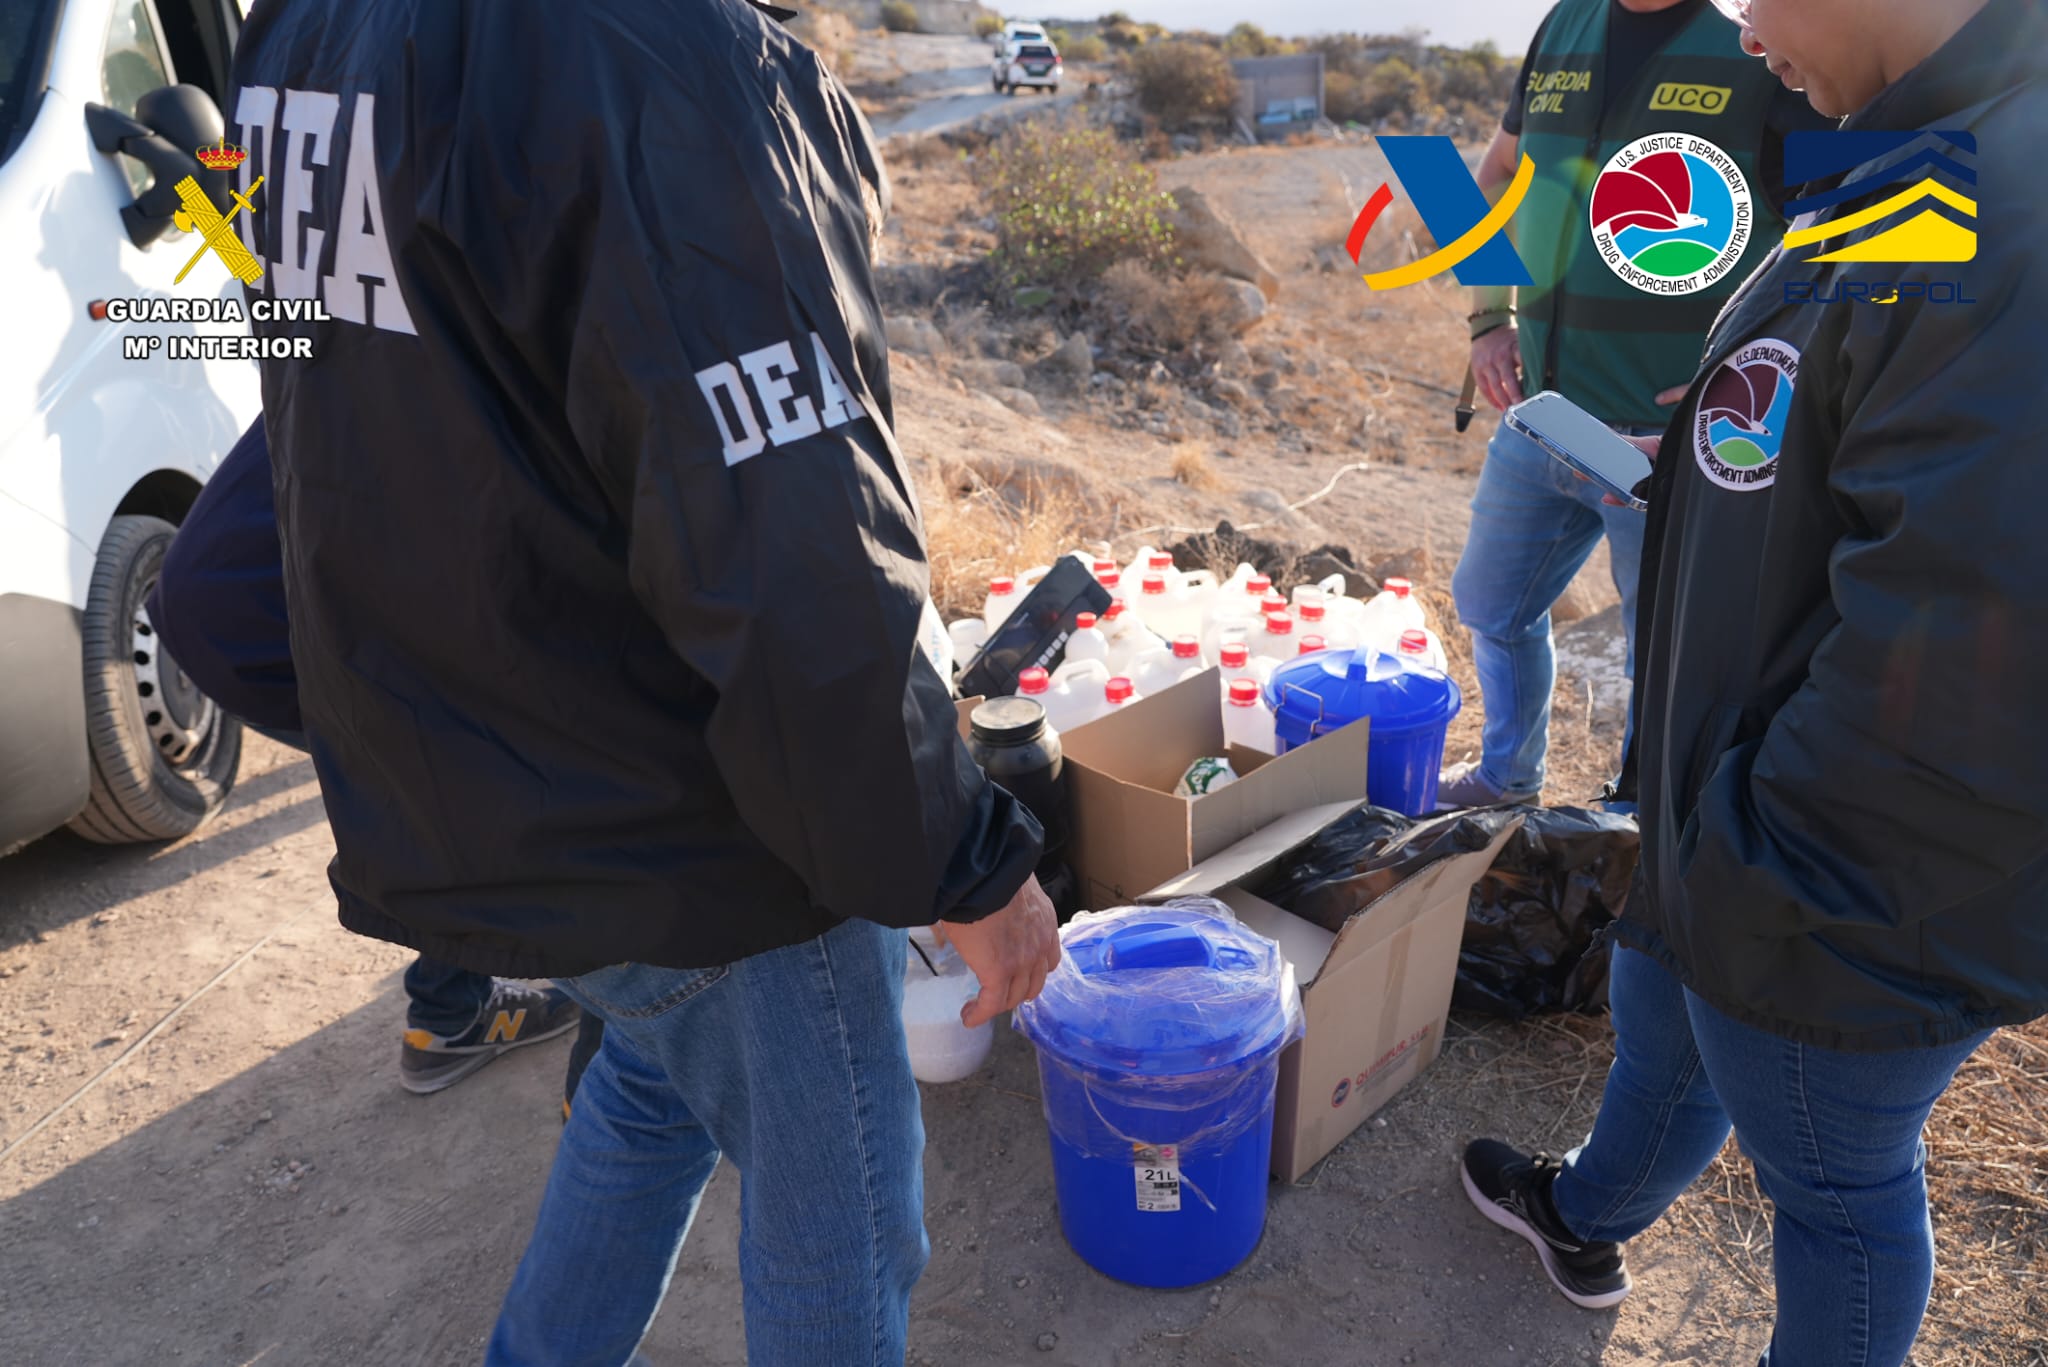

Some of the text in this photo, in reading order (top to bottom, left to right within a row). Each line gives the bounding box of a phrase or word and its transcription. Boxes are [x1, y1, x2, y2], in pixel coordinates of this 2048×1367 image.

[1526, 70, 1592, 92] GUARDIA
[1657, 87, 1723, 110] UCO
[1529, 93, 1564, 113] CIVIL
[234, 85, 419, 337] DEA
[694, 331, 868, 467] DEA
[1699, 438, 1744, 483] ENFORCEMENT
[484, 1008, 527, 1043] N
